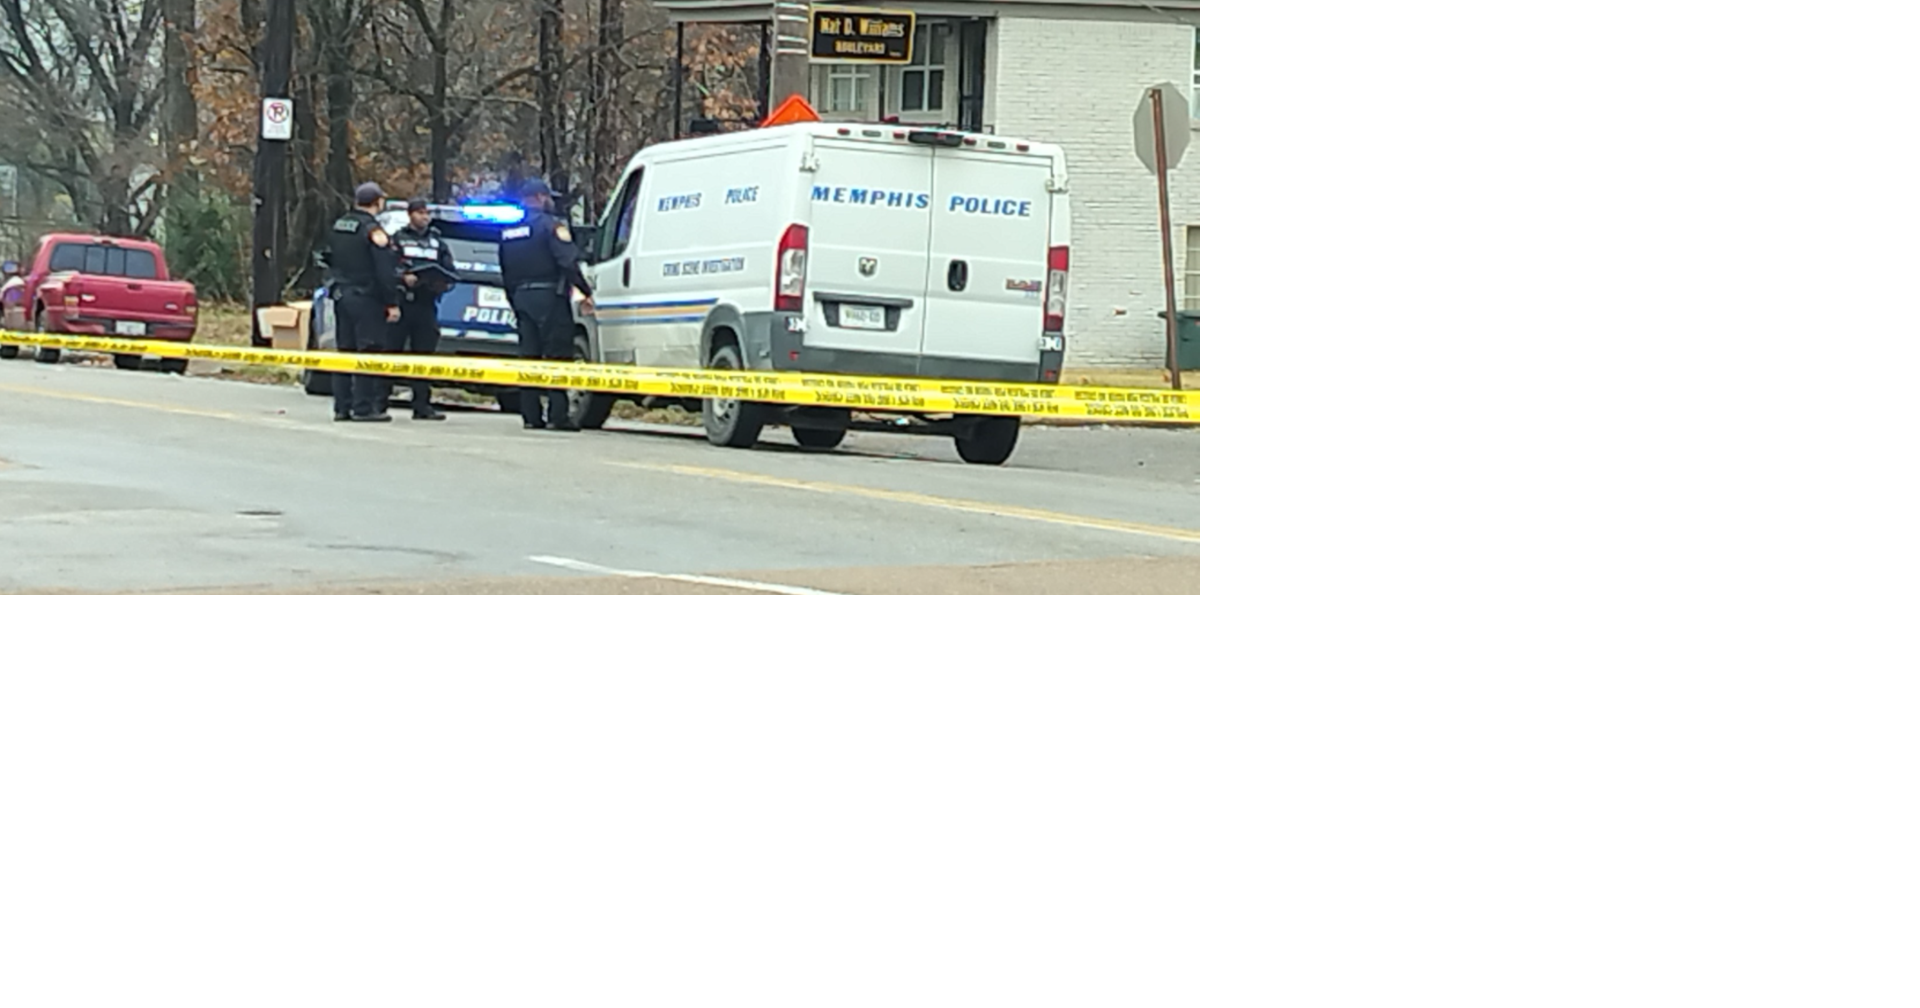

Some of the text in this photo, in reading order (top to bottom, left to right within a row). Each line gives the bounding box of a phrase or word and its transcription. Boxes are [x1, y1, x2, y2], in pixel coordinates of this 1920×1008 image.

[820, 16, 841, 35] Nat
[843, 17, 856, 36] D.
[811, 186, 1032, 217] MEMPHIS POLICE
